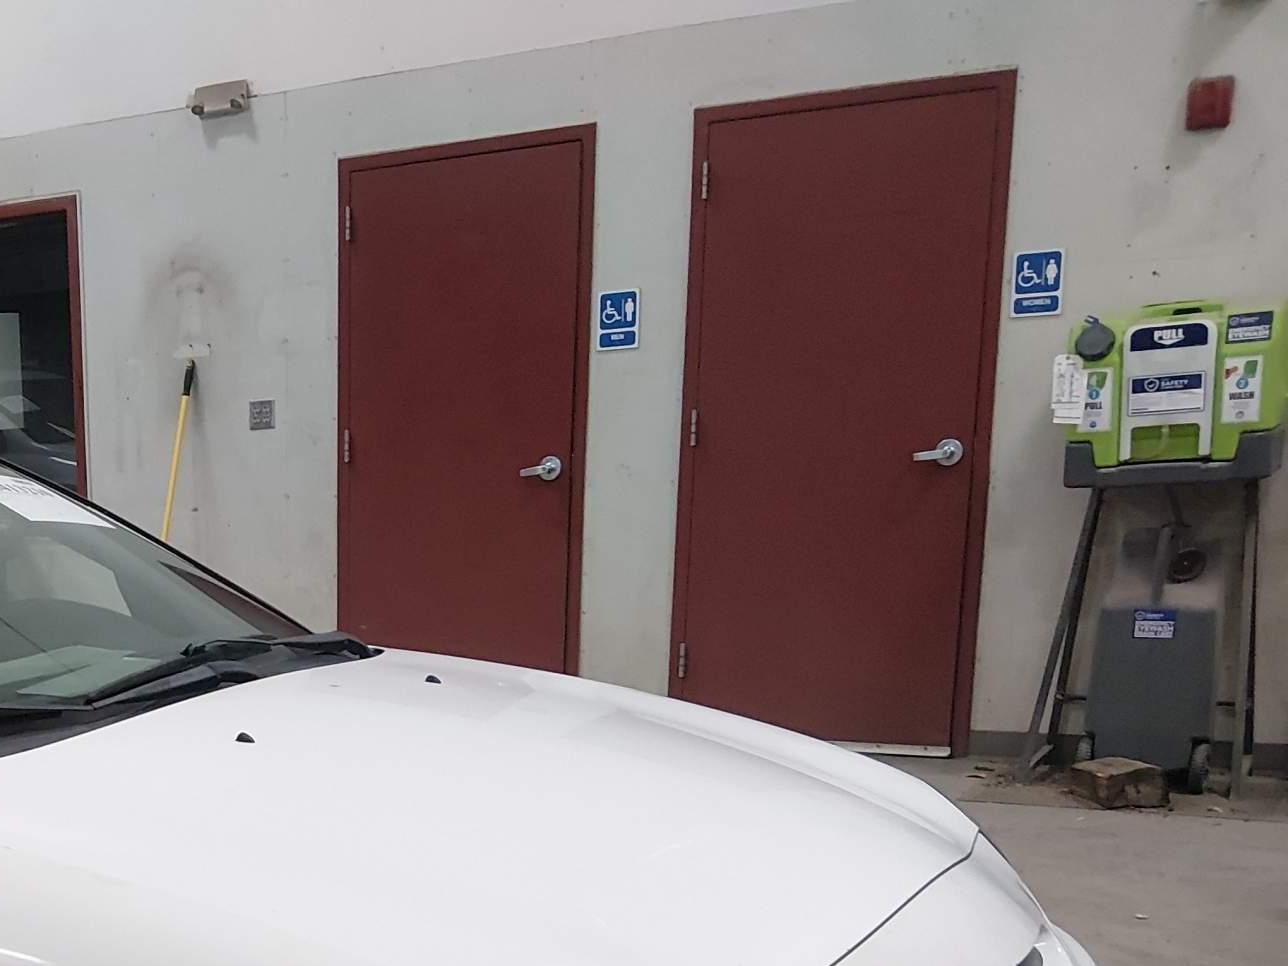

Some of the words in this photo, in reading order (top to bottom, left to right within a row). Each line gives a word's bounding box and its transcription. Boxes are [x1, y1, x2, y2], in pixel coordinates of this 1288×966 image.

[1154, 328, 1184, 341] PULL
[1229, 392, 1255, 400] WASH
[1085, 401, 1103, 410] PULL
